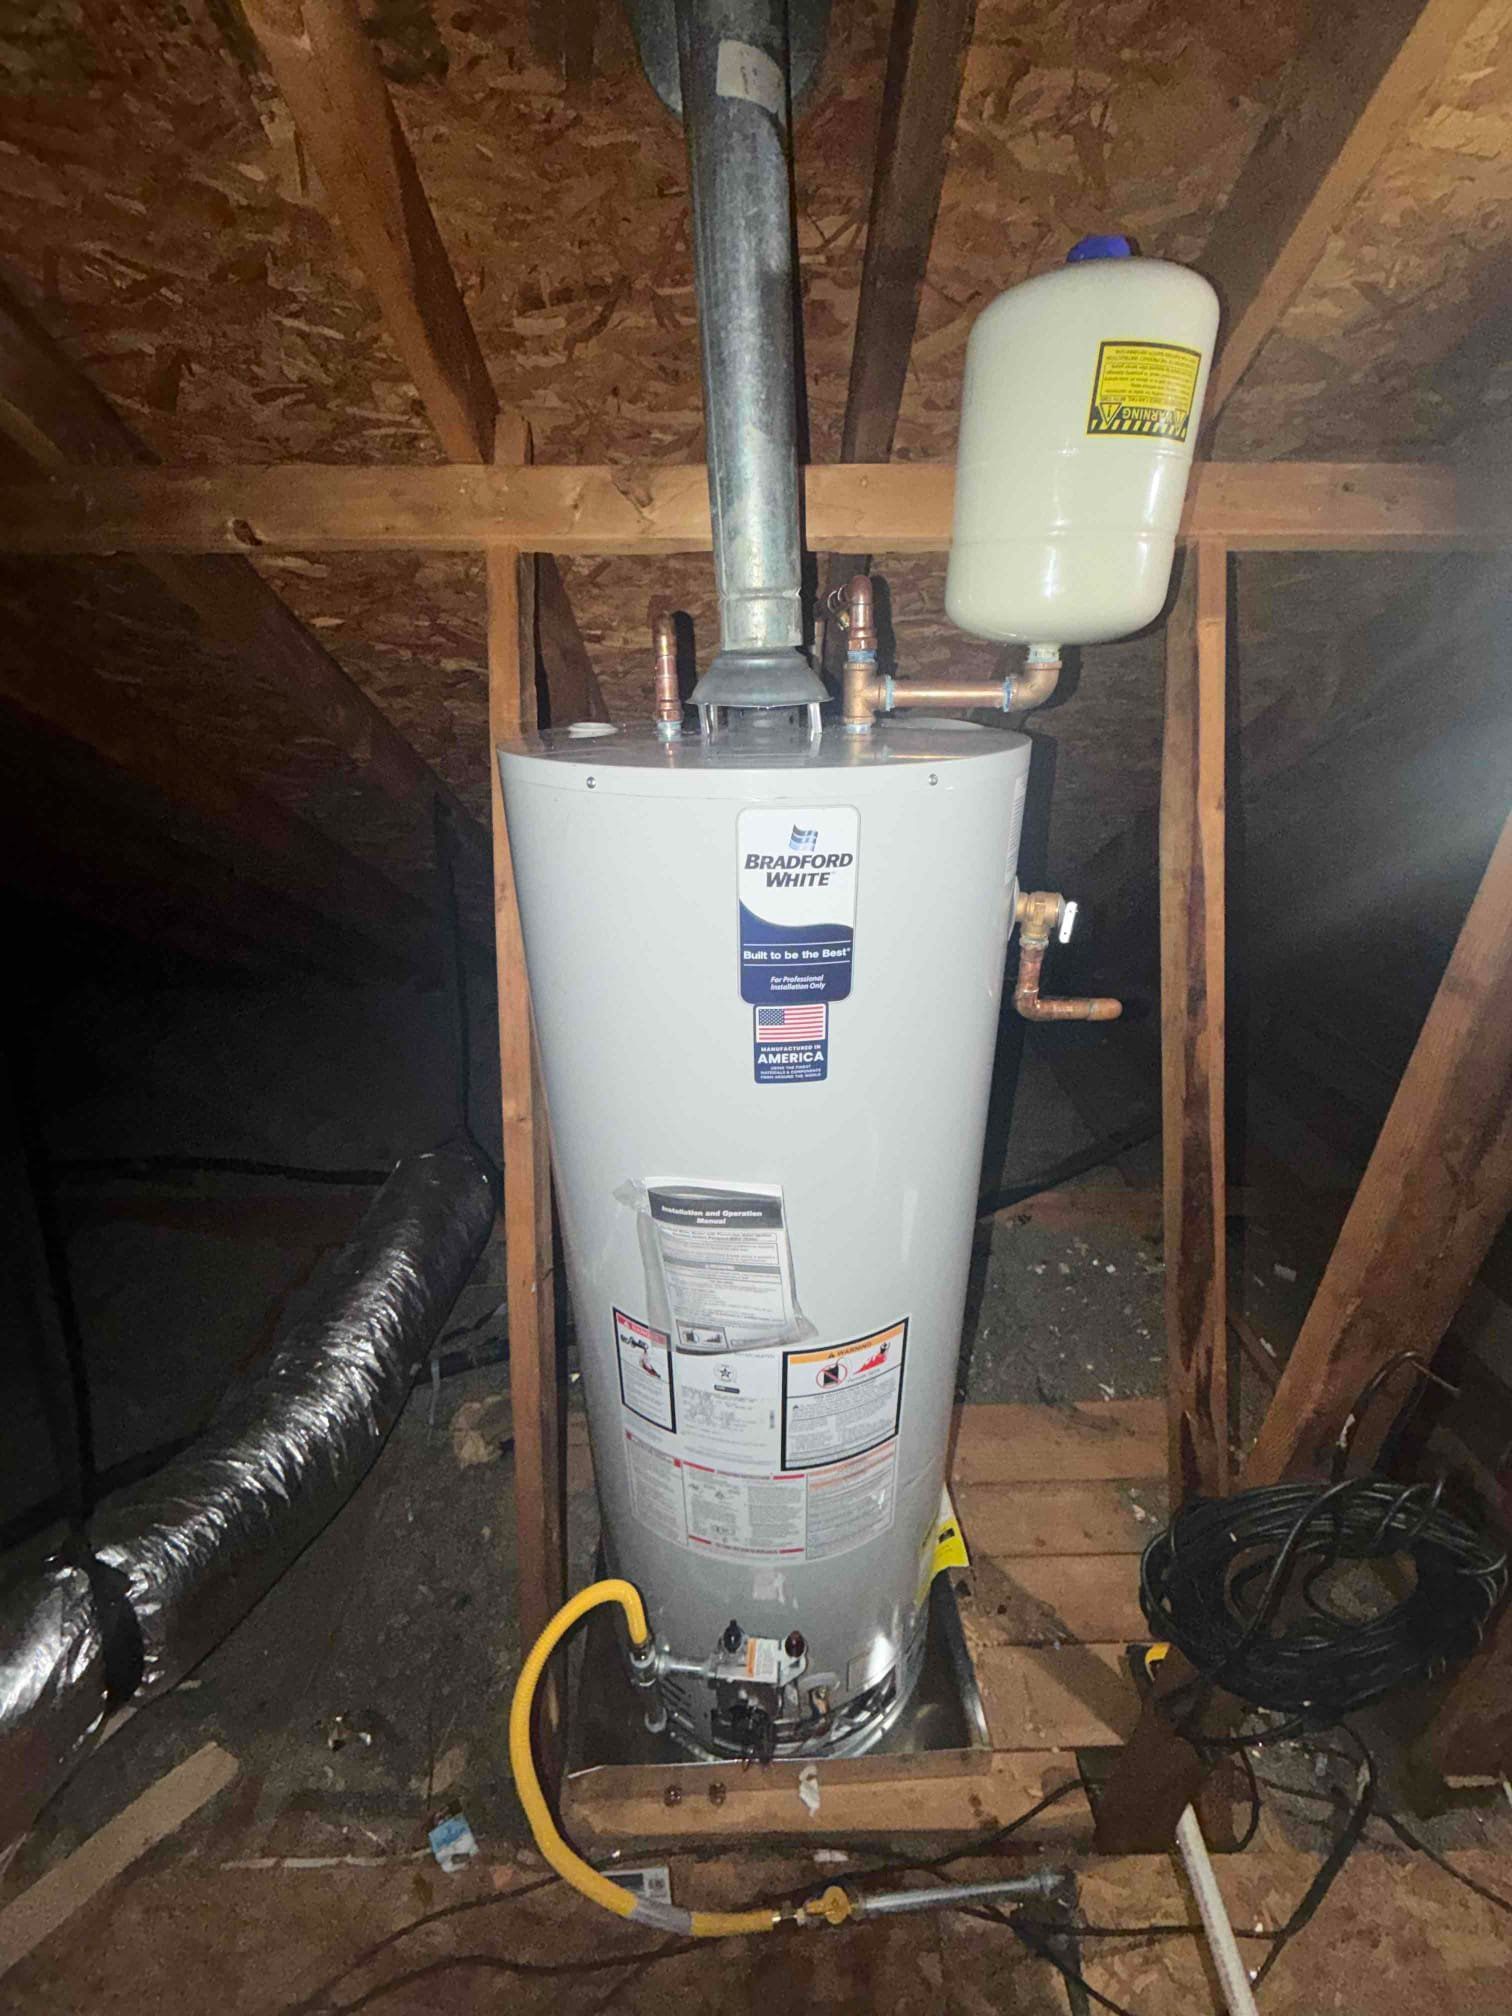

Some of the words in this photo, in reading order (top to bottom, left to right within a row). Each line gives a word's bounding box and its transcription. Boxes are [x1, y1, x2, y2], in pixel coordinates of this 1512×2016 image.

[1122, 408, 1174, 423] WARNING
[745, 853, 854, 870] BRADFORD
[766, 871, 831, 888] WHITE
[743, 950, 768, 960] Built
[770, 951, 782, 960] to
[784, 950, 799, 960] be
[802, 950, 819, 959] the
[782, 974, 825, 983] Professional
[770, 983, 809, 991] Installation
[810, 982, 826, 991] Only
[757, 1050, 825, 1064] AMERICA
[661, 1205, 704, 1217] Installation
[722, 1210, 763, 1218] Operation
[696, 1217, 727, 1225] Manual
[836, 1341, 873, 1357] WARNING
